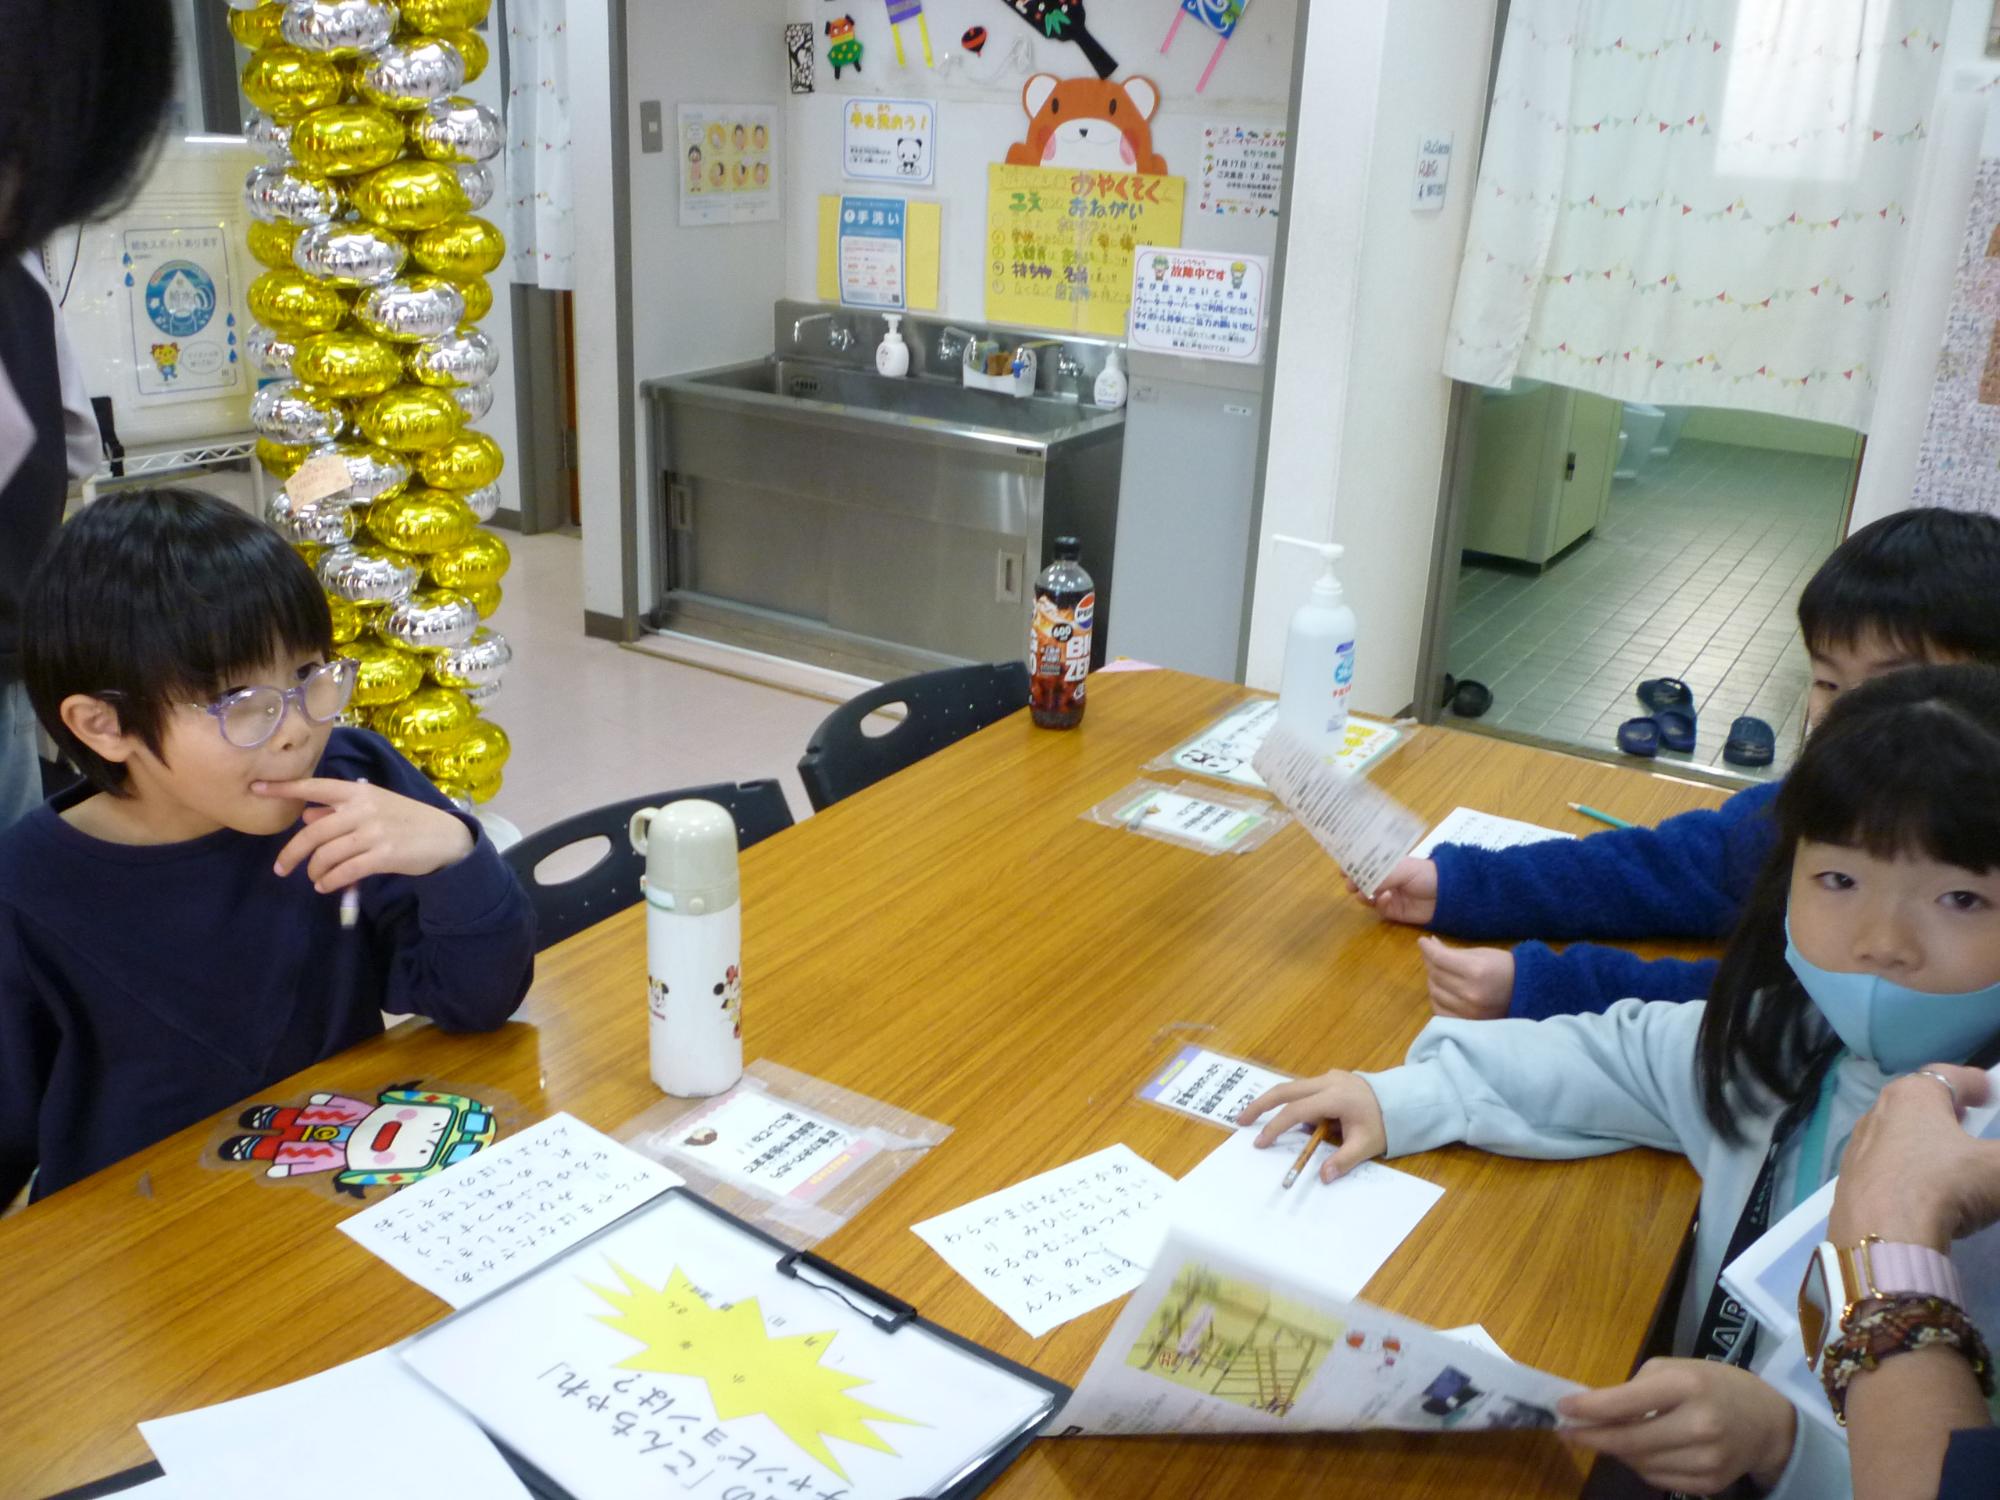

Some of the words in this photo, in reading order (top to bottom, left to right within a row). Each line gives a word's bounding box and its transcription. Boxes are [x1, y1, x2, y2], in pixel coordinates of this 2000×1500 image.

[1068, 197, 1143, 221] おねがい
[1170, 265, 1226, 281] 故障中です
[1053, 627, 1072, 638] 600
